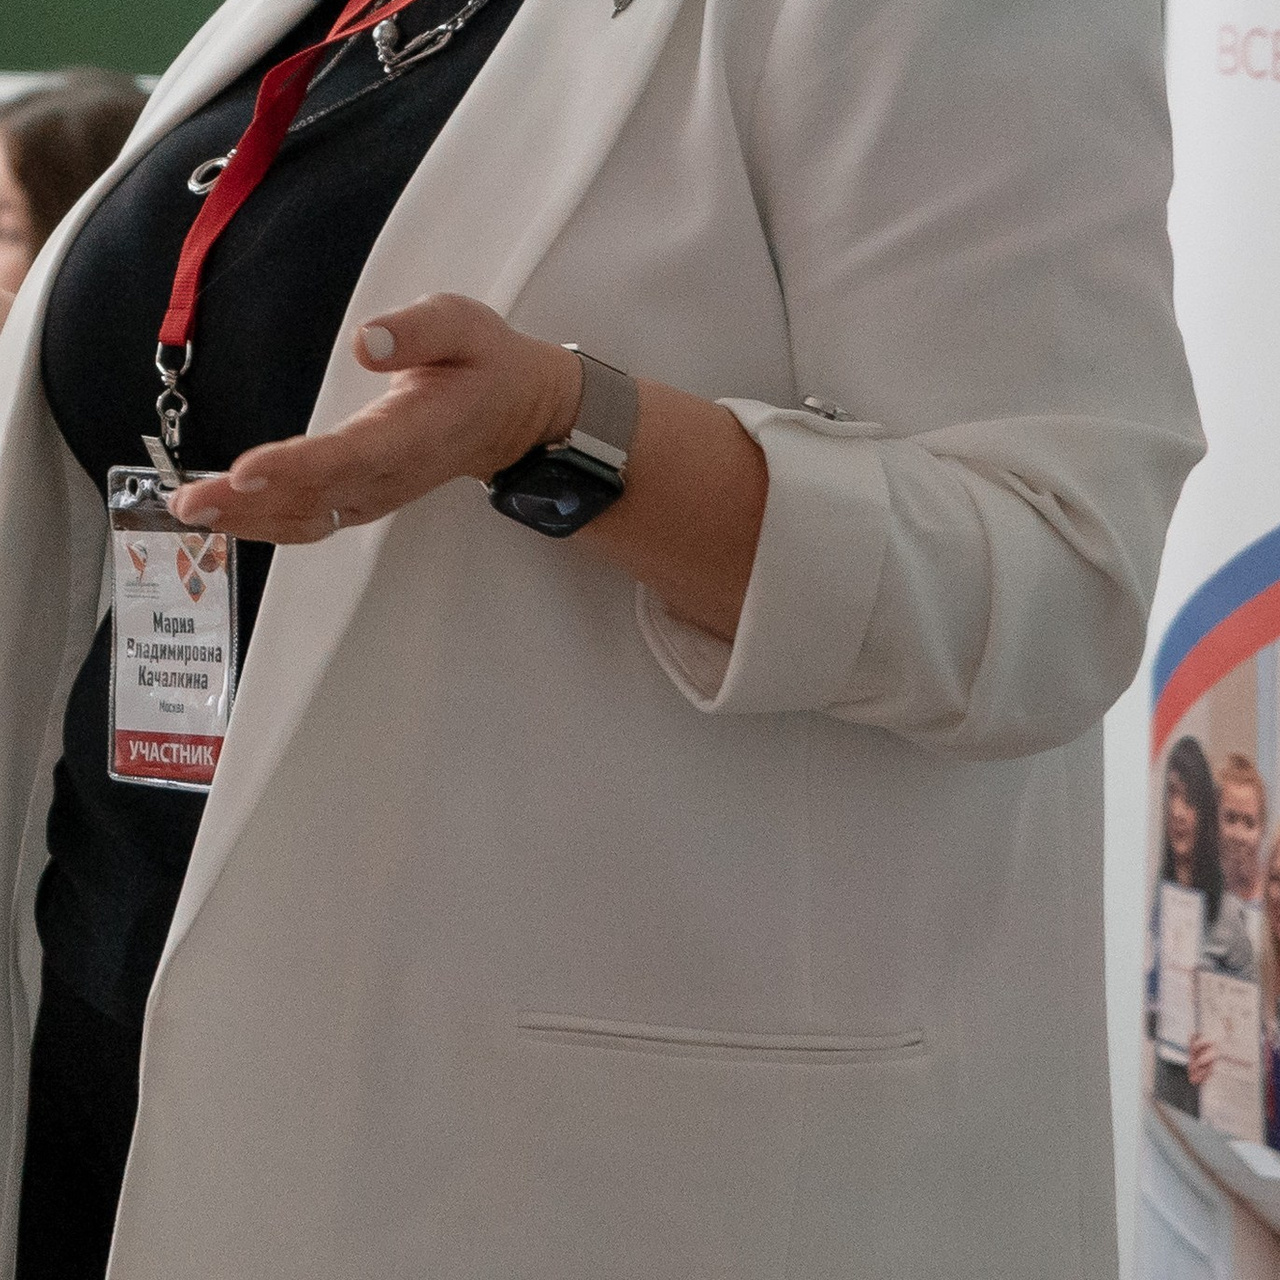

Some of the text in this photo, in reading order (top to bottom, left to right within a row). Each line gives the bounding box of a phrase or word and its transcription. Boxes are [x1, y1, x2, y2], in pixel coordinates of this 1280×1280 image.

[153, 611, 194, 637] Мария
[126, 638, 222, 665] Владимировна
[138, 665, 208, 690] Качалкина
[158, 700, 184, 713] Москва
[129, 740, 215, 766] УЧАСТНИК
